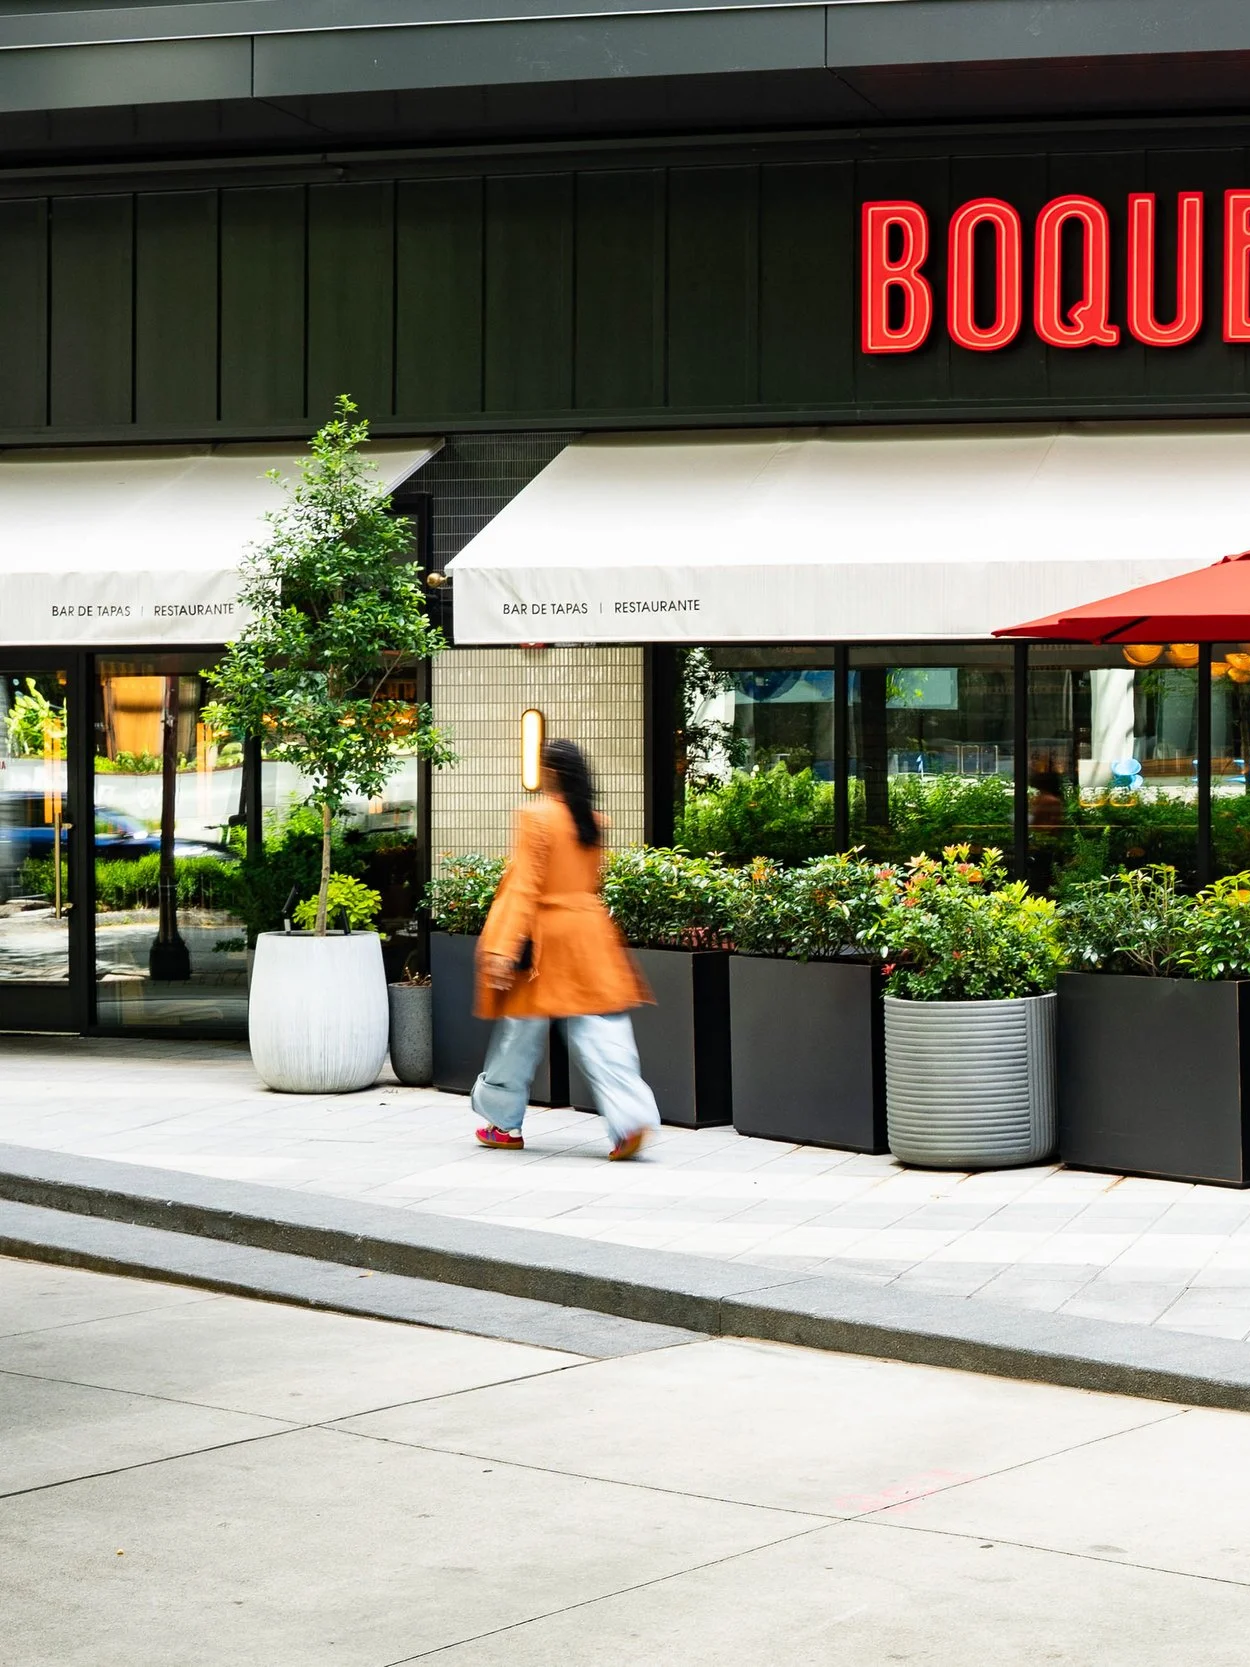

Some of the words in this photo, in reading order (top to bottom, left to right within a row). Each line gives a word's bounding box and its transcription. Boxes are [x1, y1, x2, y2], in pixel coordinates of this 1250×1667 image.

[51, 605, 75, 617] BAR
[77, 605, 93, 617] DE
[96, 605, 131, 617] TAPAS
[154, 602, 234, 617] RESTAURANTE
[502, 603, 528, 615] BAR
[531, 603, 548, 615] DE
[550, 602, 589, 615] TAPAS
[614, 599, 701, 614] RESTAURANTE
